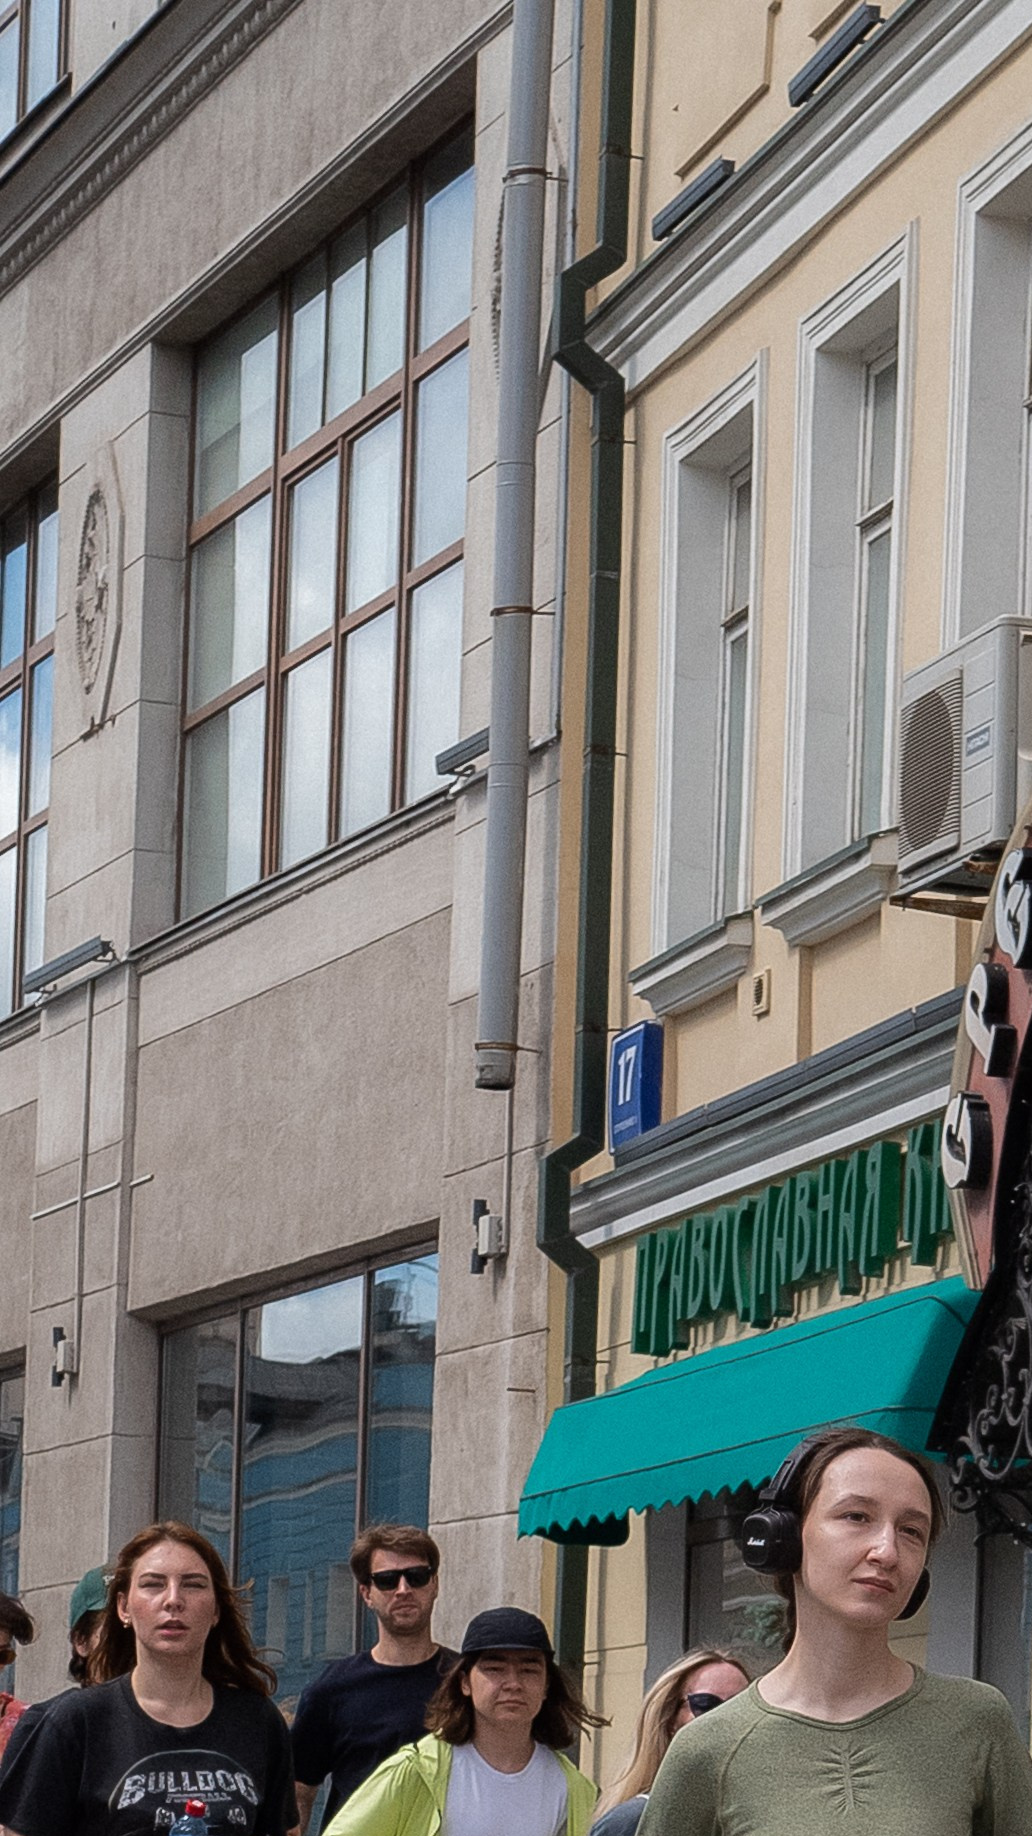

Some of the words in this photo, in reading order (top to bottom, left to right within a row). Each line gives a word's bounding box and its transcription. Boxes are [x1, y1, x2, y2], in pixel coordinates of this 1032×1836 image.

[617, 1045, 637, 1106] 17
[631, 1141, 888, 1357] ПРАВОСЛАВНАЯ
[903, 1118, 954, 1266] КН
[117, 1769, 259, 1810] BULLDOG
